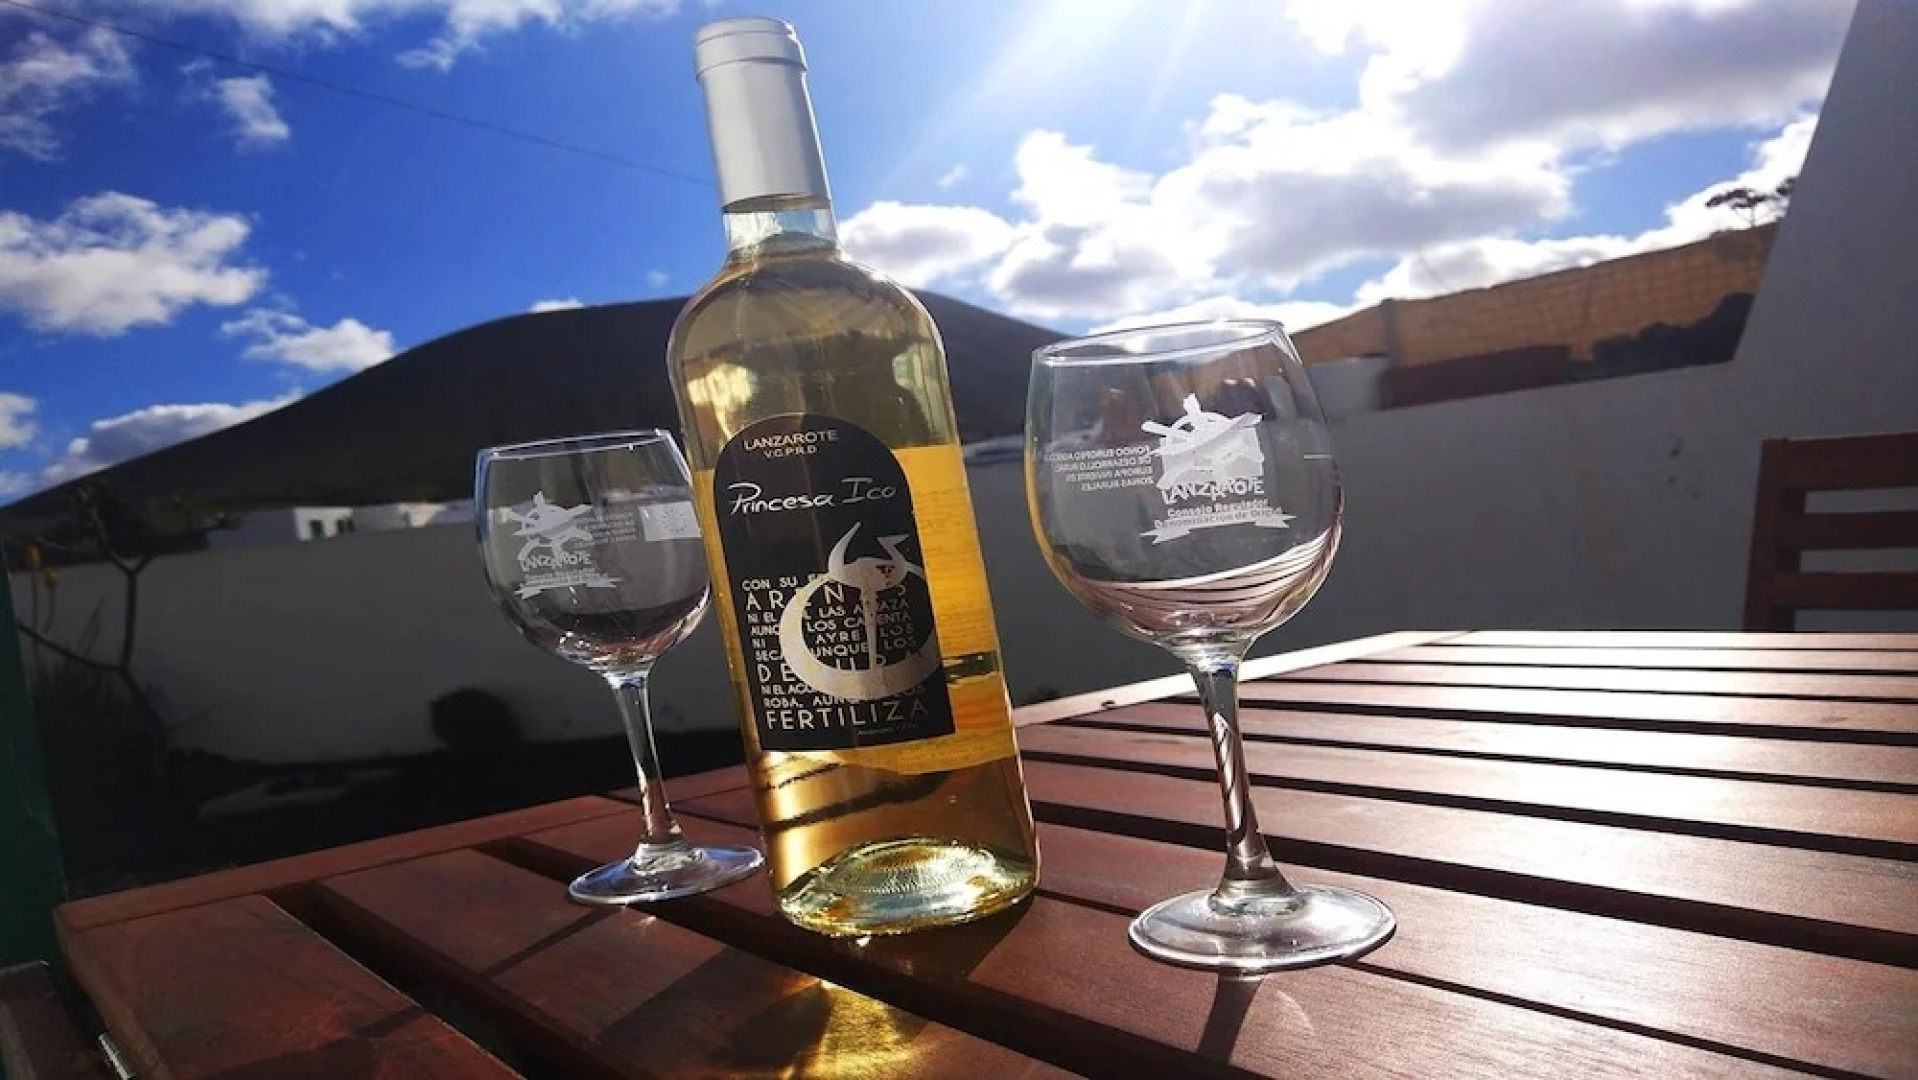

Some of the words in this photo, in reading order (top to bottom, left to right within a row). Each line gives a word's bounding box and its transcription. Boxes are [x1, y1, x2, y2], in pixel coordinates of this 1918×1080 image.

[744, 429, 838, 450] LANZAROTE
[728, 482, 835, 517] Princesa
[842, 477, 897, 504] Ico
[1162, 477, 1265, 505] LANZAROTE
[741, 578, 770, 591] CON
[779, 576, 798, 589] SU
[819, 605, 846, 618] LAS
[806, 619, 836, 632] LOS
[766, 698, 929, 730] FERTILIZA
